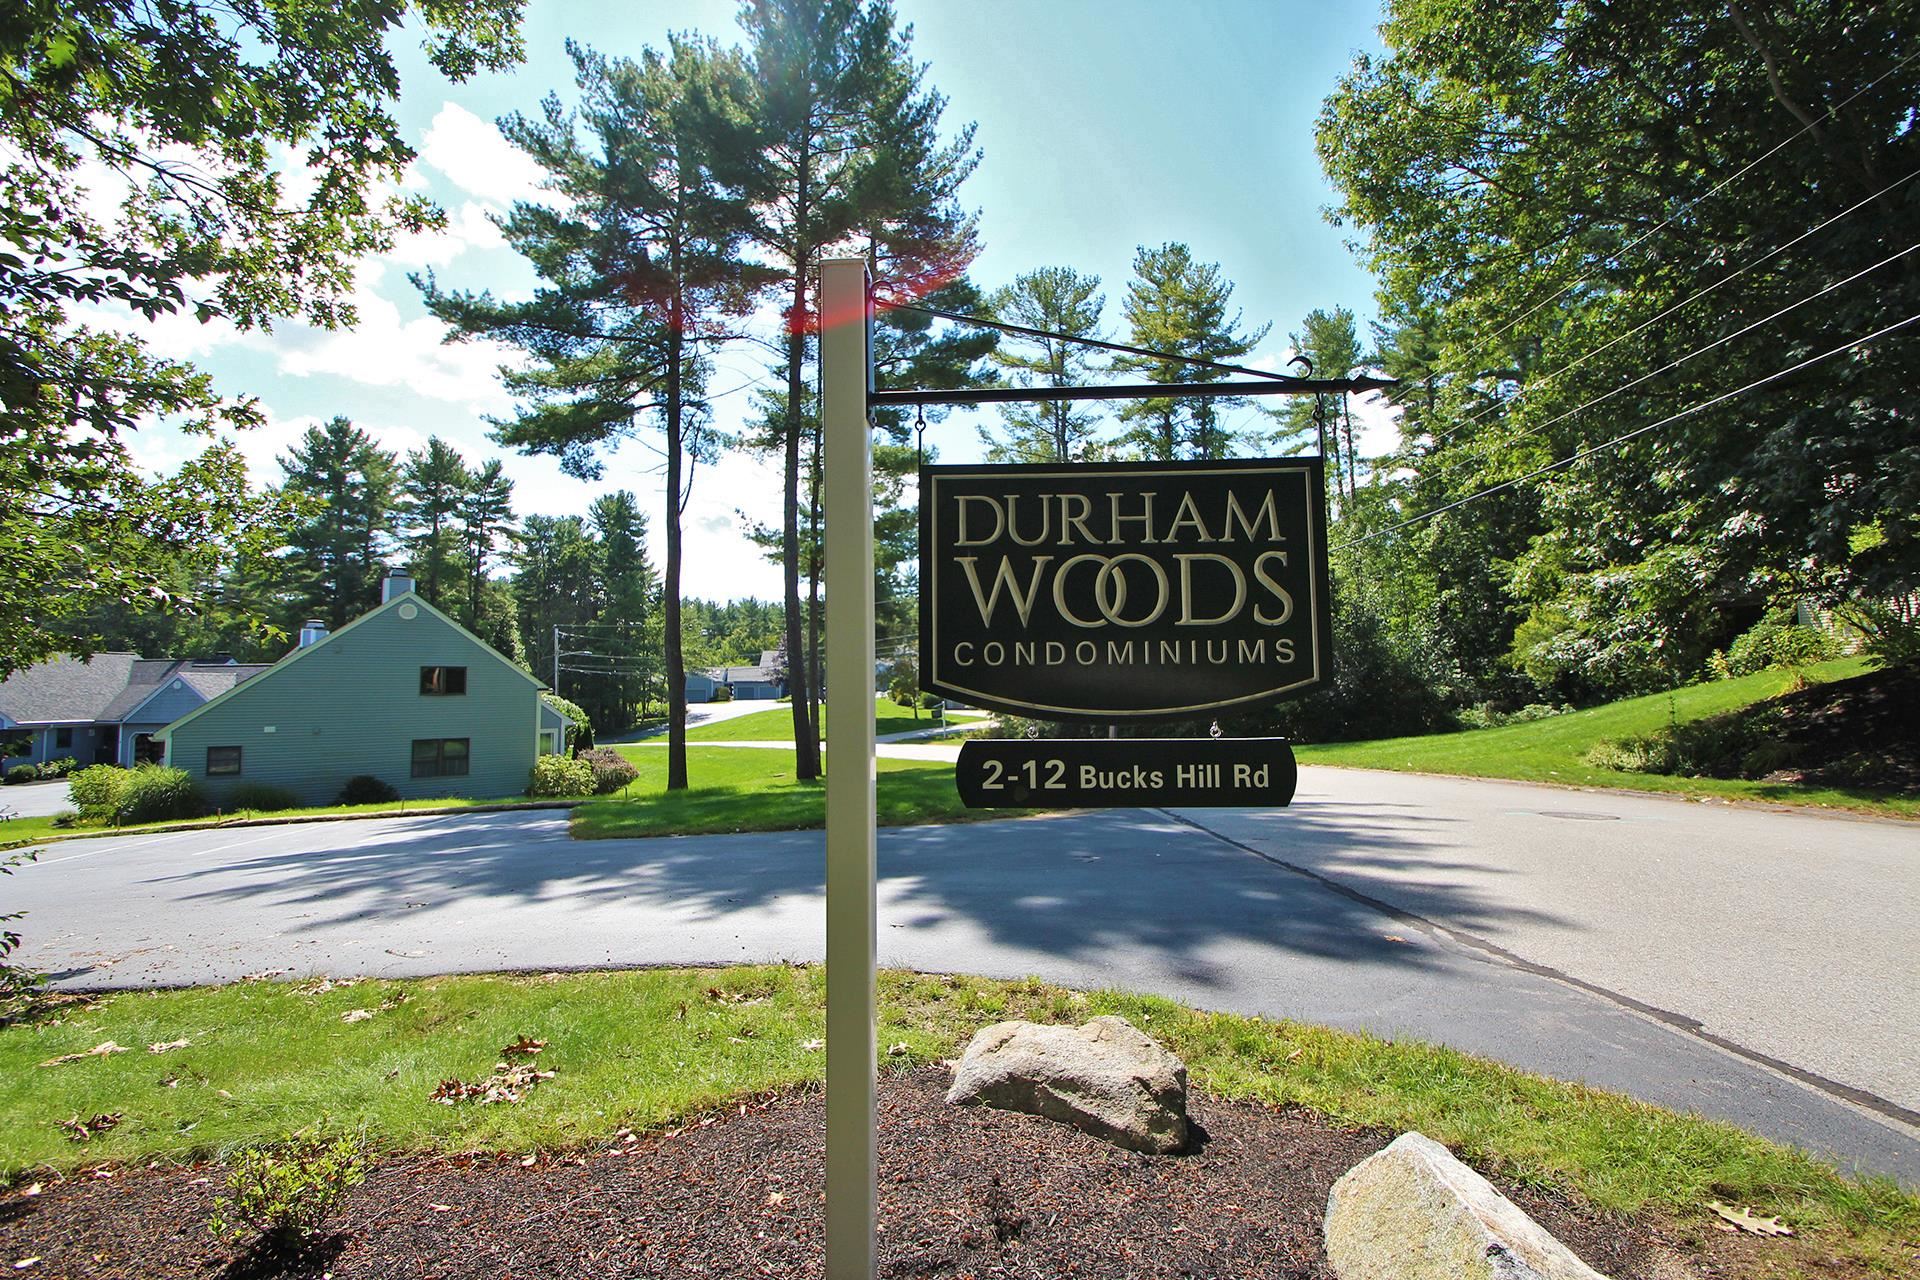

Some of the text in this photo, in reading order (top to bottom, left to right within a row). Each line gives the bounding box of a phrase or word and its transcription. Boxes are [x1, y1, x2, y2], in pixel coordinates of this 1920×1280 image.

[954, 489, 1286, 546] DURHAM
[954, 551, 1293, 629] WOODS
[954, 639, 1295, 666] CONDOMINIUMS
[982, 760, 1269, 790] 2-12 Bucks Hill Rd
